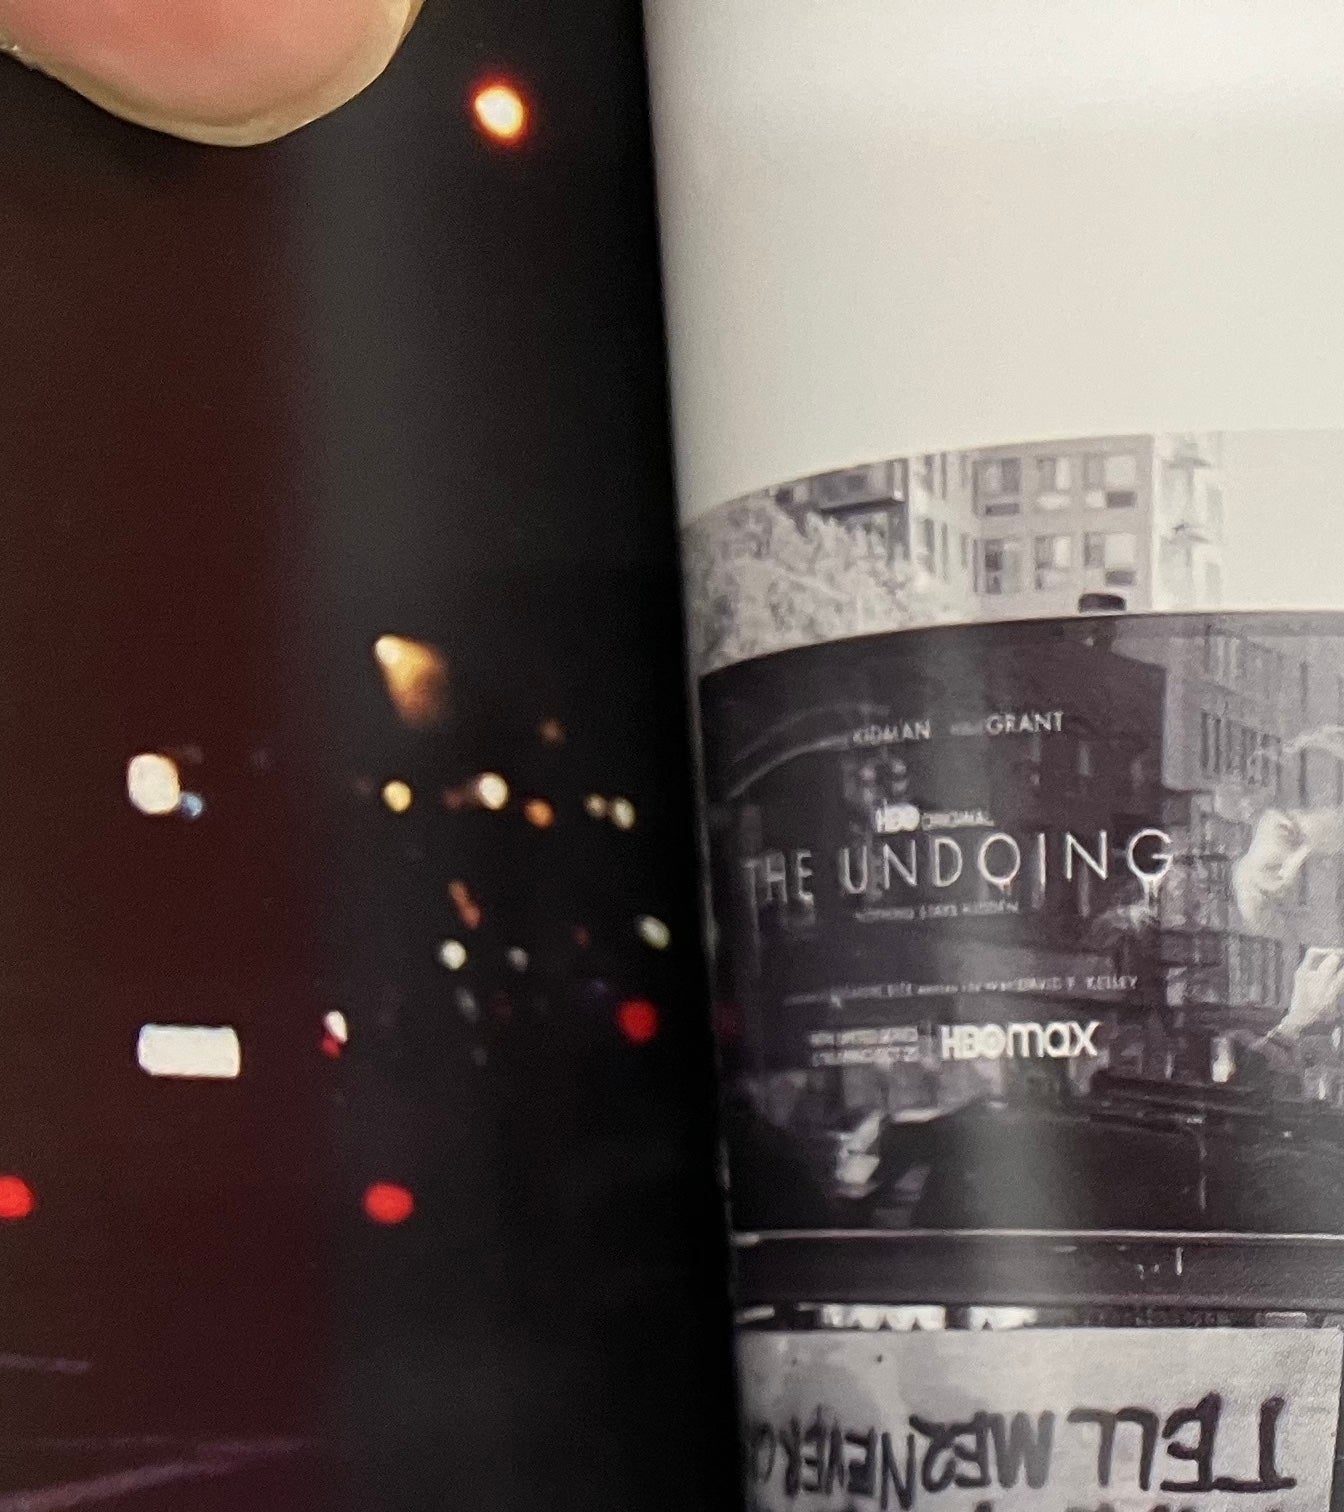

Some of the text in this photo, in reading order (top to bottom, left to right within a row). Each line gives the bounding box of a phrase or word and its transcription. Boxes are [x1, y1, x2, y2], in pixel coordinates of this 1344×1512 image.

[985, 710, 1064, 736] GRANT
[742, 827, 1174, 906] THE UNDOING
[779, 1408, 917, 1512] NEVER
[1067, 1392, 1297, 1493] TELL
